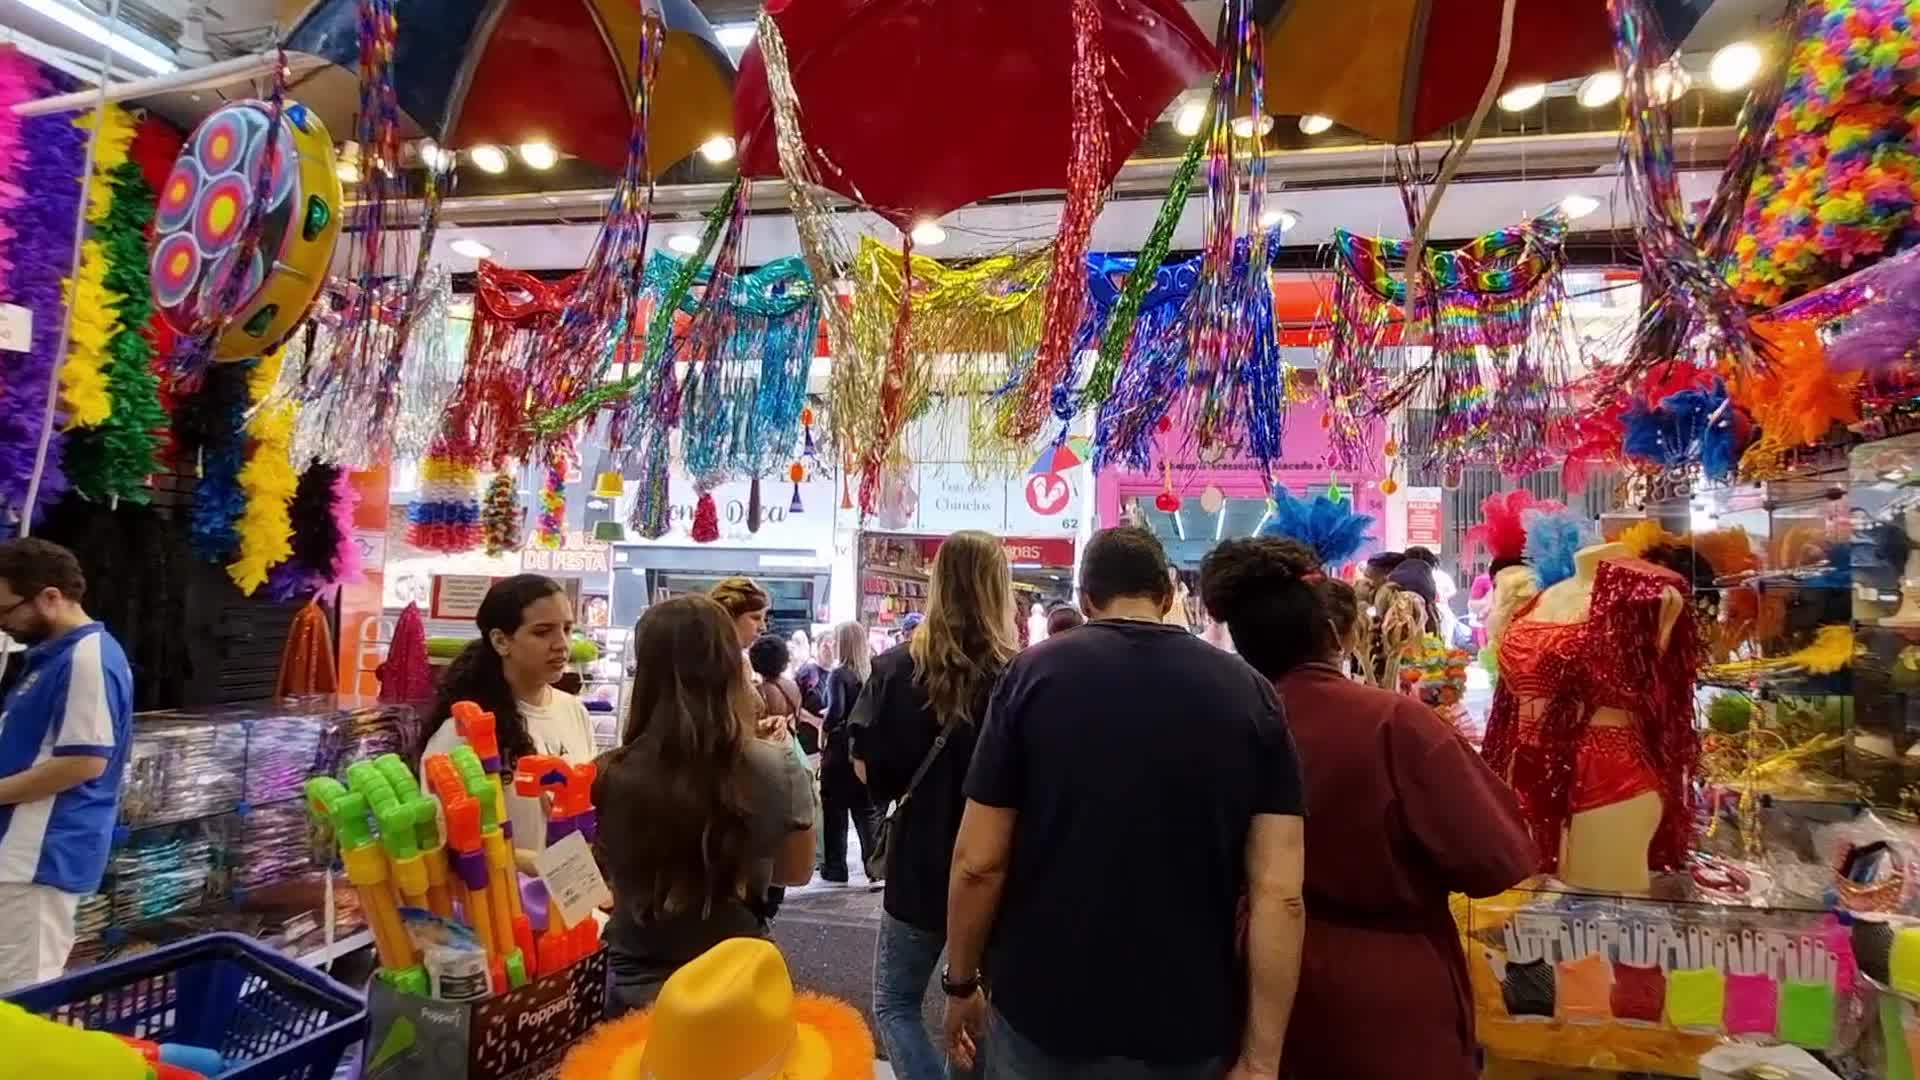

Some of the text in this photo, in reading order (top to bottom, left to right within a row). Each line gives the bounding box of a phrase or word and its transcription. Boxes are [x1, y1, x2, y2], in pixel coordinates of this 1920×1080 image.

[935, 497, 993, 512] Chinelos
[1061, 518, 1079, 529] 62
[551, 550, 609, 571] FESTA
